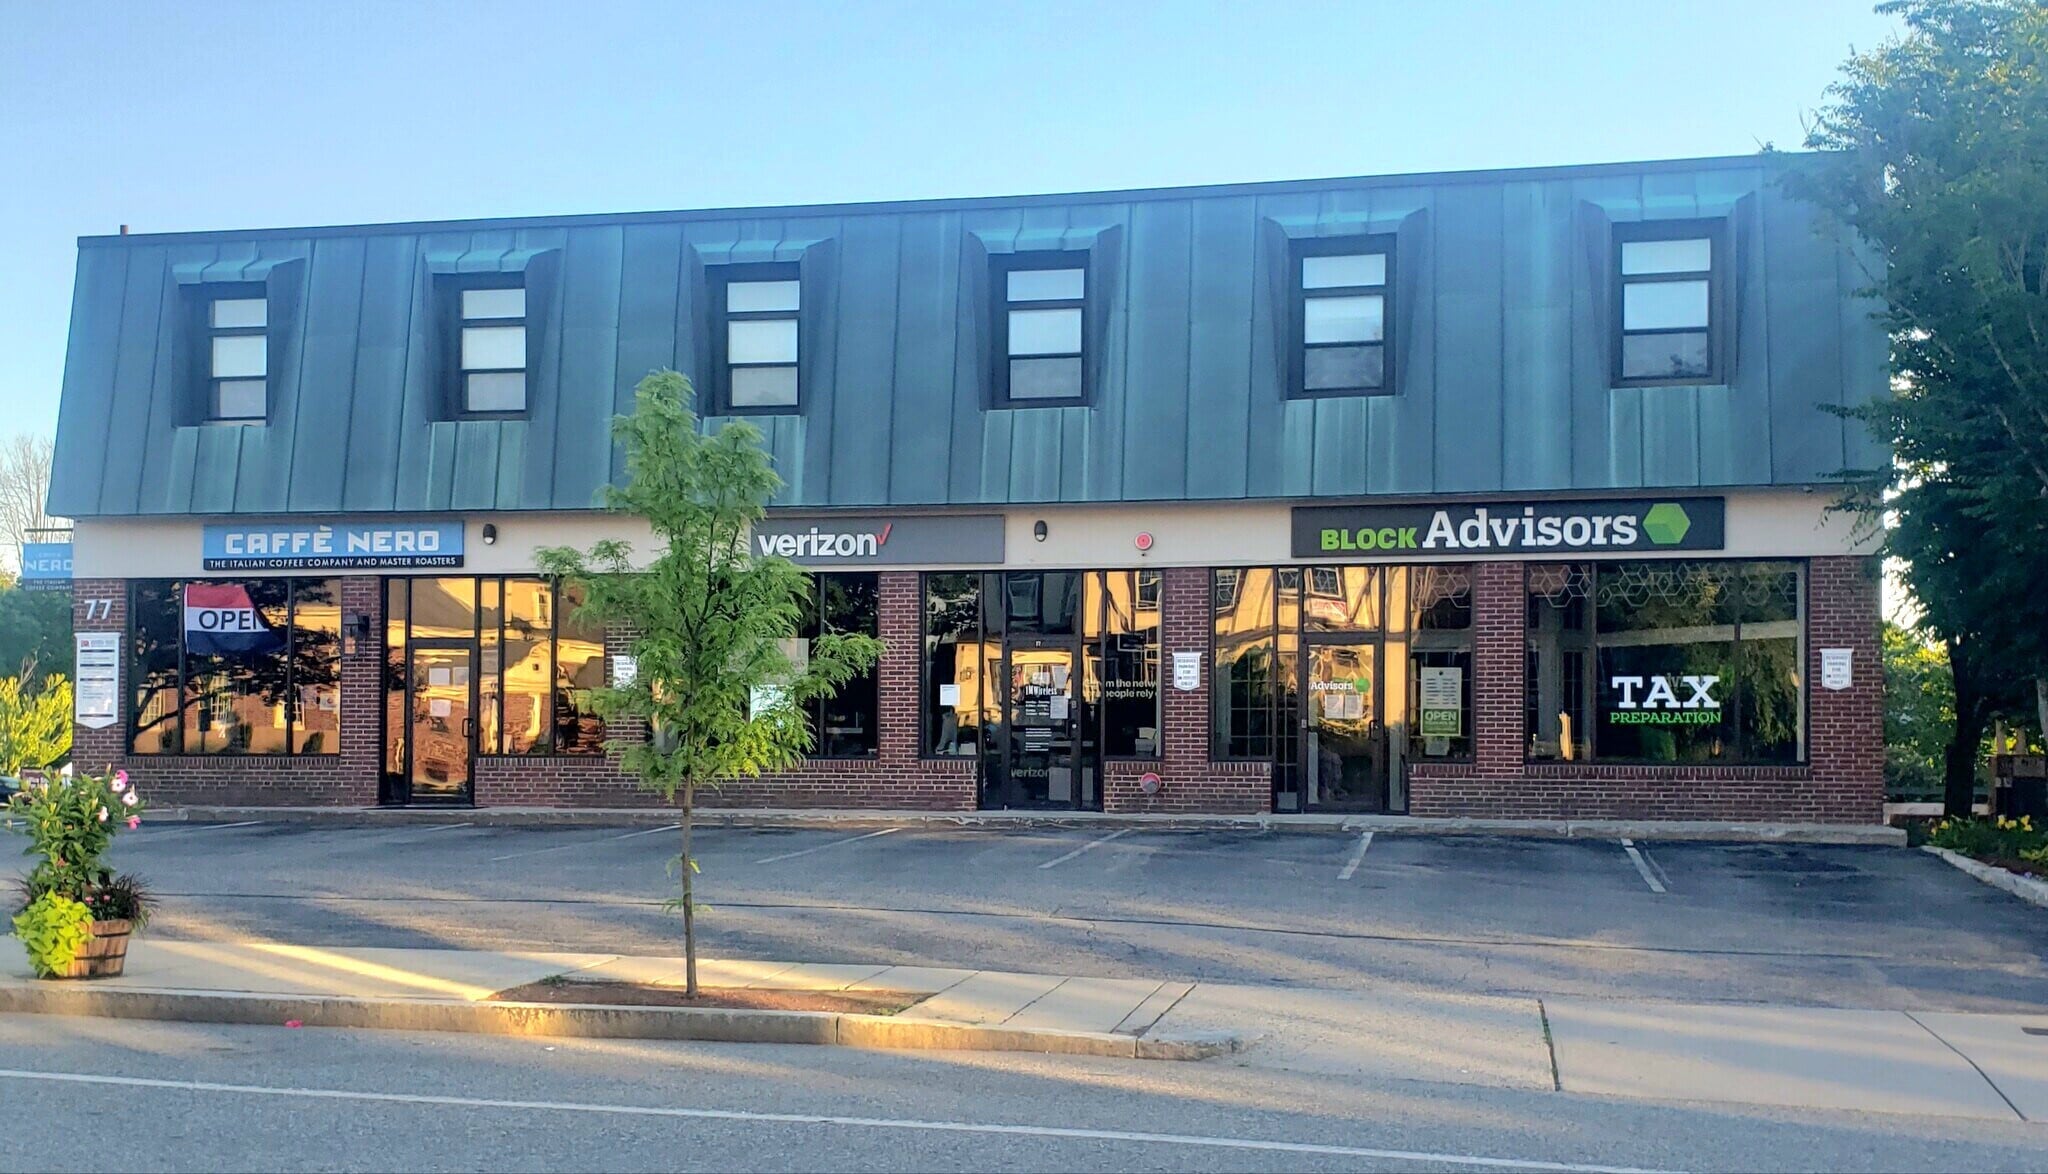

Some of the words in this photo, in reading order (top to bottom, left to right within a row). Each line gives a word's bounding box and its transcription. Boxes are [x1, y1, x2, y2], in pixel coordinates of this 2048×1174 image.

[1321, 527, 1417, 550] BLOCK
[1422, 507, 1637, 548] Advisors
[225, 524, 333, 554] CAFFÈ
[347, 530, 440, 553] NERO
[757, 527, 877, 557] verizon
[25, 559, 73, 571] NERO
[210, 560, 226, 568] THE
[230, 560, 266, 568] ITALIAN
[269, 559, 304, 568] COFFEE
[307, 558, 354, 567] COMPANY
[357, 558, 377, 566] AND
[380, 558, 412, 566] MASTER
[415, 556, 456, 566] ROASTERS
[84, 600, 112, 620] 77
[1115, 679, 1131, 688] the
[1310, 681, 1353, 690] Advisors
[1136, 689, 1154, 699] rely
[1612, 675, 1720, 708] TAX
[1425, 711, 1457, 721] OPEN
[1610, 711, 1721, 724] PREPARATION
